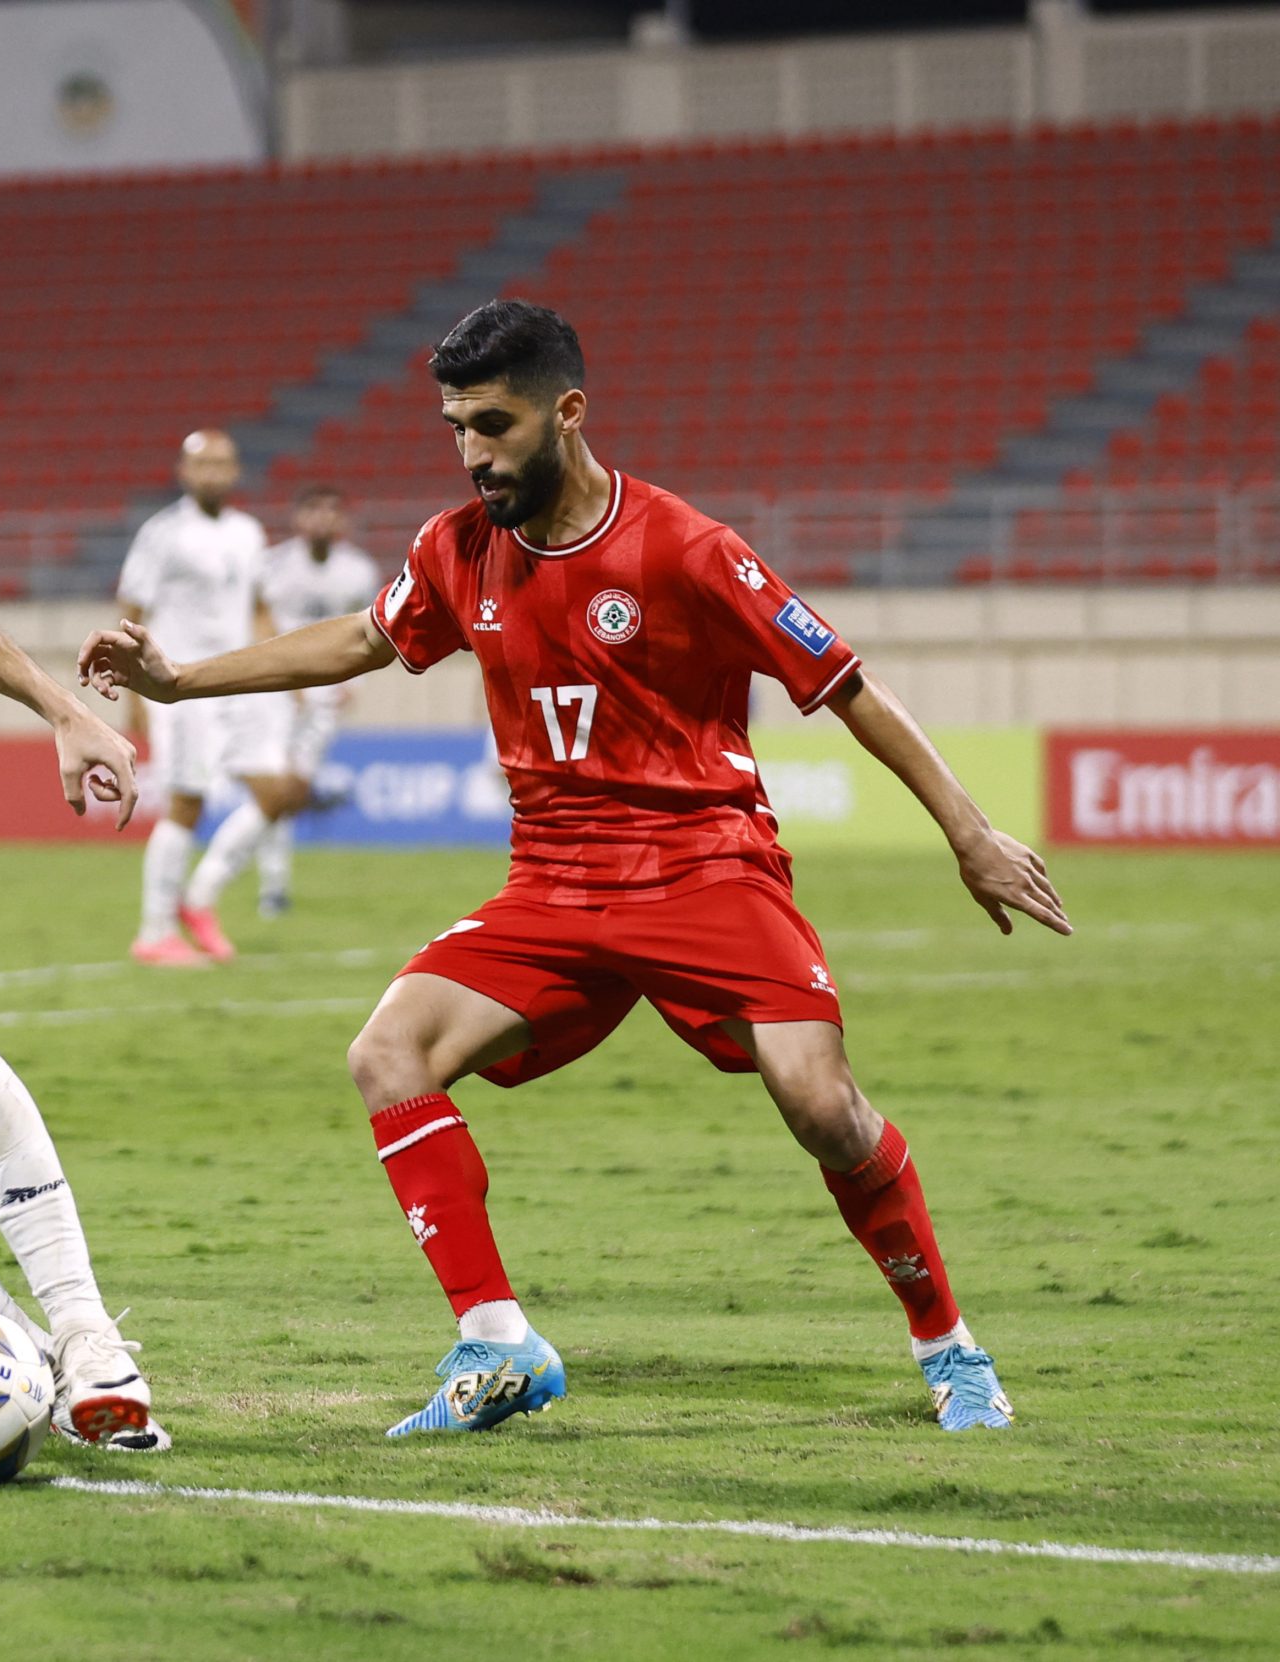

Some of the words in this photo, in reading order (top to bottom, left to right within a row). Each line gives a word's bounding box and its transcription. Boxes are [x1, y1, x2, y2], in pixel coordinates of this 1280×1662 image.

[473, 623, 502, 631] KELME
[593, 625, 627, 640] LEBANON
[531, 684, 598, 761] 17
